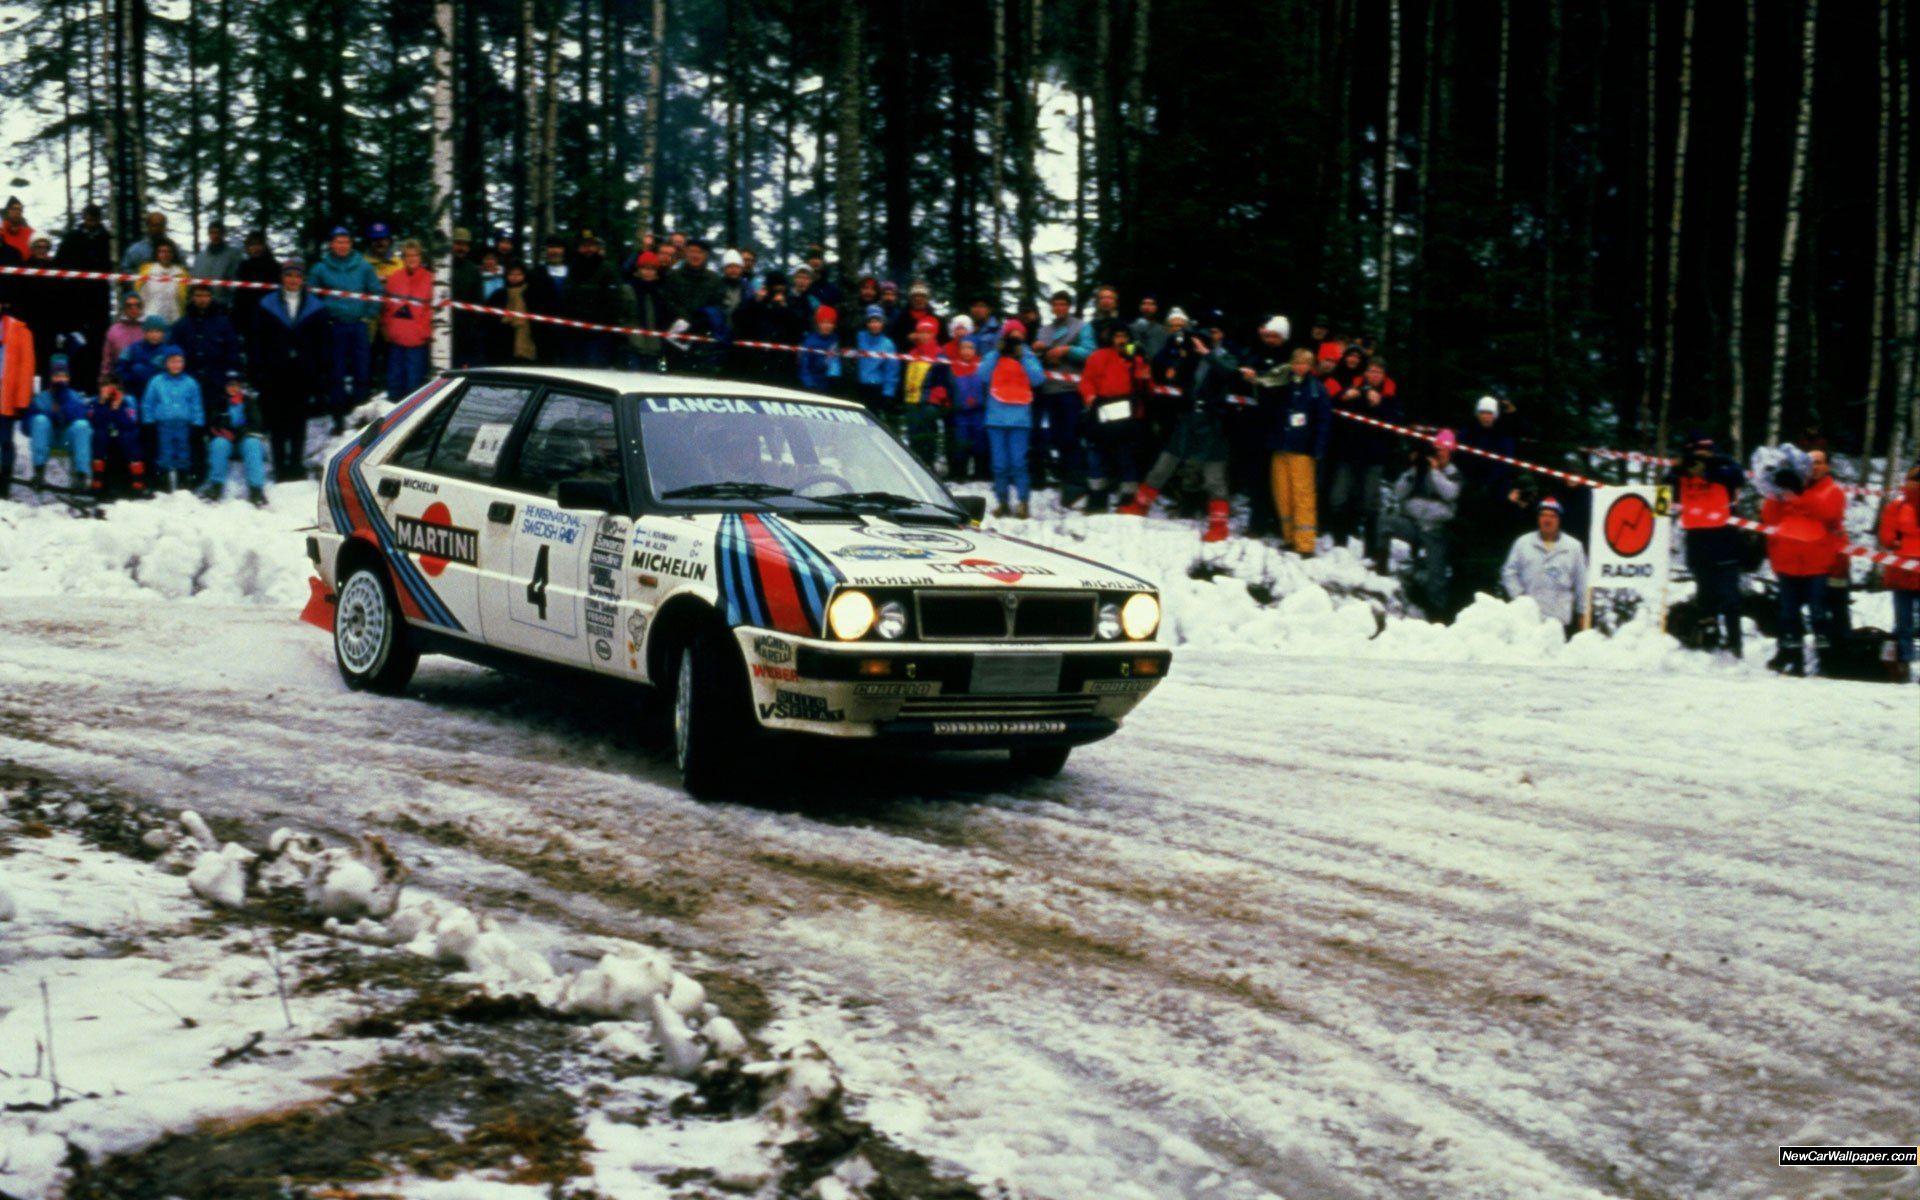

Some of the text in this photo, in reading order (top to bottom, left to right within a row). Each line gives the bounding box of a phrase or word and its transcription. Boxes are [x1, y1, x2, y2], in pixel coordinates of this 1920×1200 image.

[646, 397, 868, 426] LANCIA MARTINI
[402, 478, 440, 495] MICHELIN
[398, 522, 475, 562] MARTINI
[631, 550, 708, 581] MICHELIN
[1602, 563, 1653, 578] RADIO
[527, 545, 550, 621] 4
[854, 576, 935, 586] MICHELIN
[1080, 578, 1147, 589] MICHELIN
